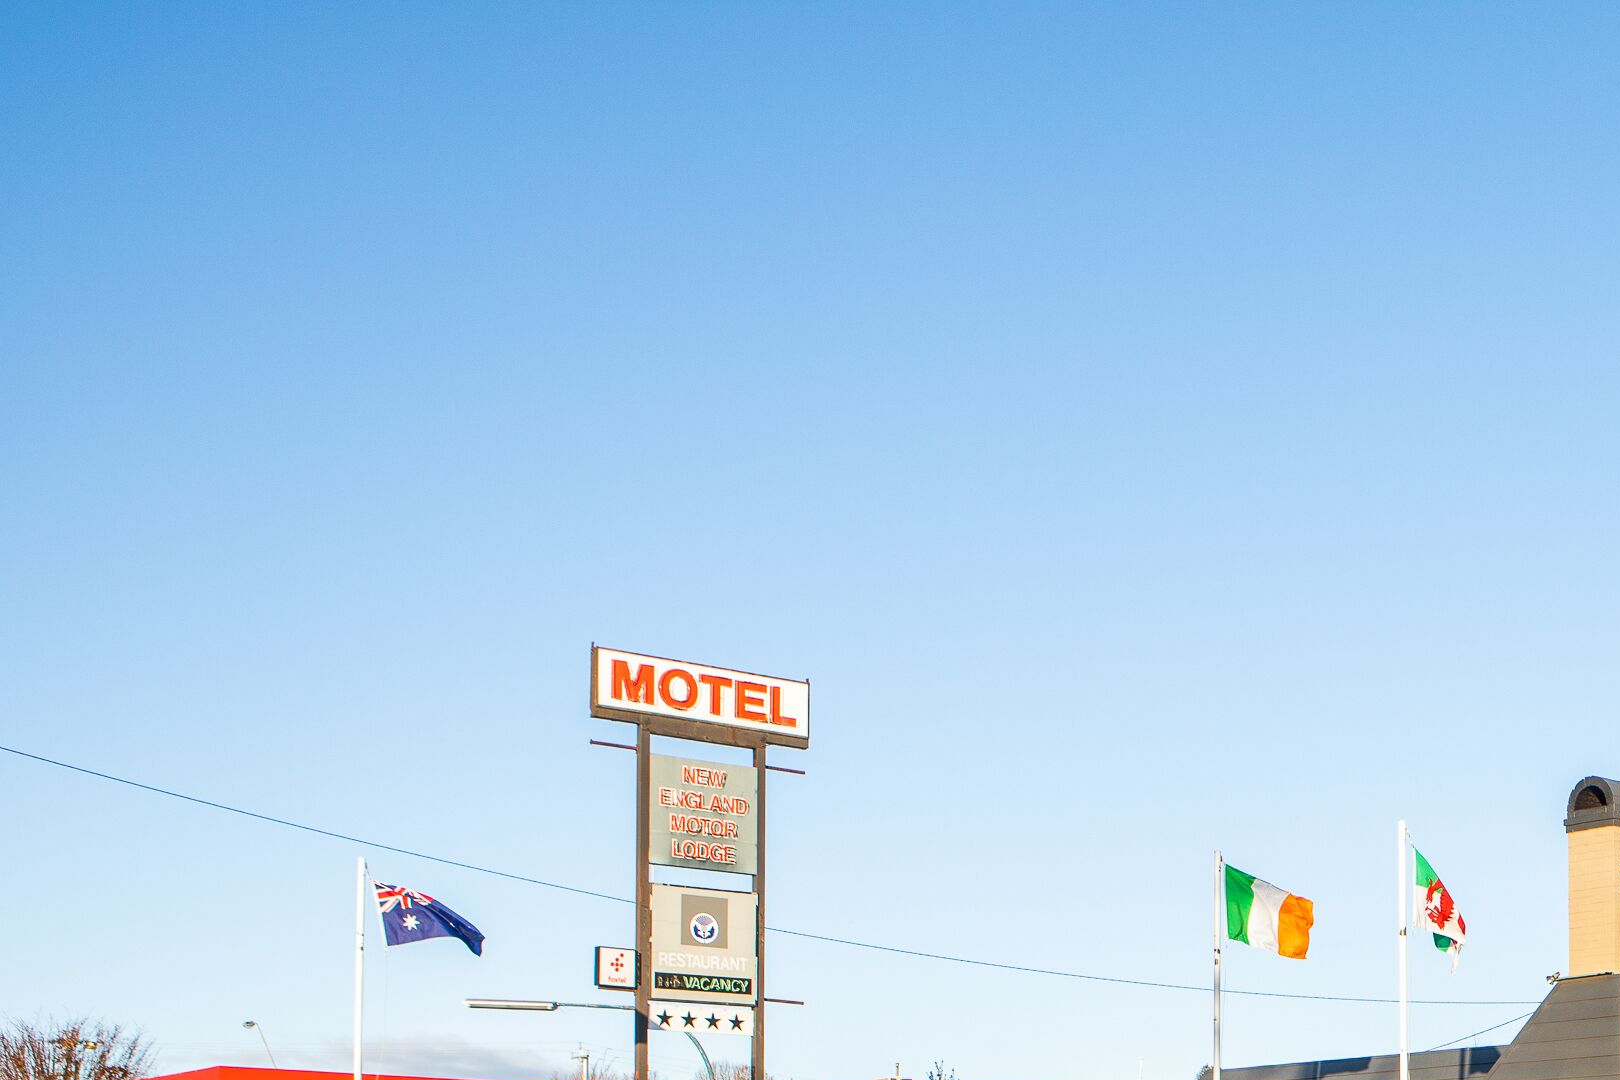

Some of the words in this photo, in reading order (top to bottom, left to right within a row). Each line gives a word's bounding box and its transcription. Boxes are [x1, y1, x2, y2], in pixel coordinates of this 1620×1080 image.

[611, 659, 797, 727] MOTEL
[682, 765, 728, 788] NEW
[659, 789, 749, 815] ENGLAND
[670, 814, 738, 839] MOTOR
[672, 840, 736, 864] LODGE
[658, 952, 749, 971] RESTAURANT
[608, 976, 627, 984] foxtel
[682, 976, 749, 993] VACANCY
